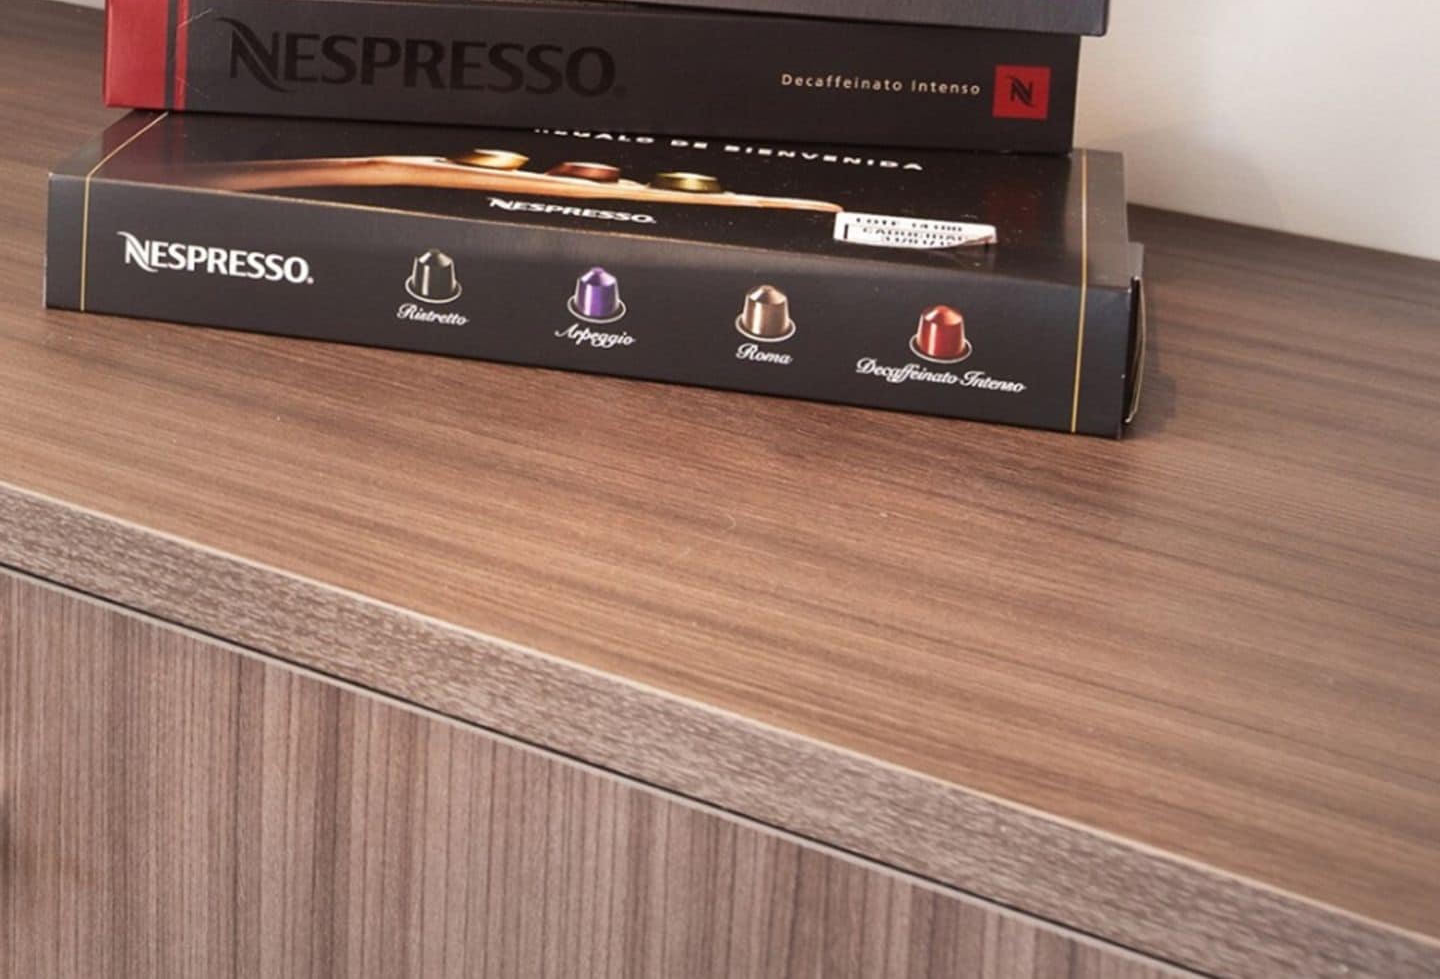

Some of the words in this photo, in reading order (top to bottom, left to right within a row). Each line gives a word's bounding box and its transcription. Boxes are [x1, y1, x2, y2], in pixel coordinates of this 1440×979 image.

[217, 16, 618, 99] NESPRESSO
[781, 73, 903, 93] Decaffeinato
[911, 79, 981, 95] Intenso
[670, 139, 708, 149] DE
[724, 144, 923, 171] BIENVENIDA
[486, 196, 654, 224] NESPRESSO
[117, 231, 310, 284] NESPRESSO
[396, 302, 469, 326] Ristretto
[554, 323, 636, 348] Arpeggio
[735, 342, 793, 364] Roma
[856, 357, 959, 384] Decaffeinato
[960, 370, 1027, 393] Intenso
